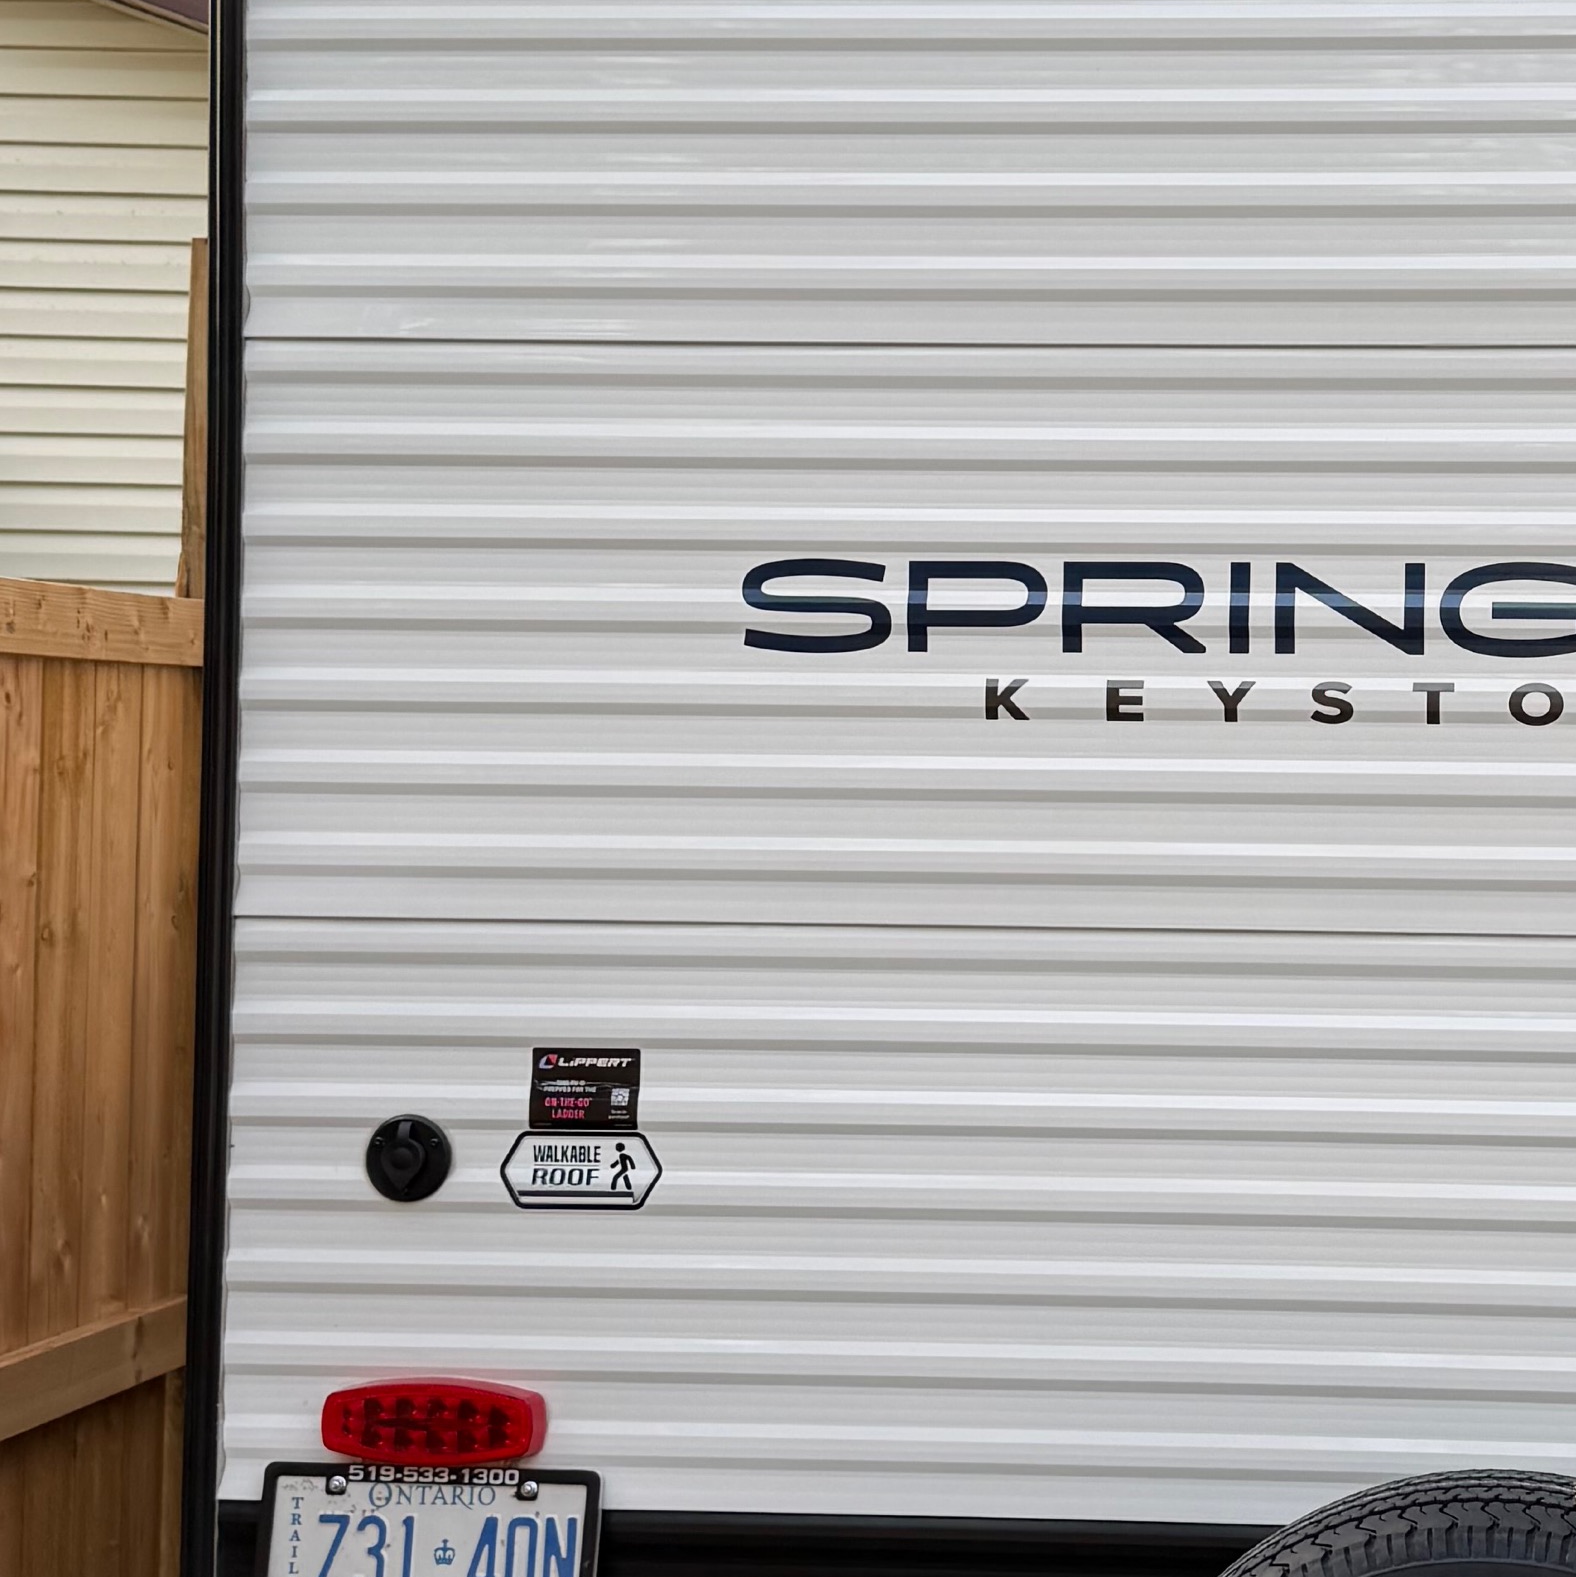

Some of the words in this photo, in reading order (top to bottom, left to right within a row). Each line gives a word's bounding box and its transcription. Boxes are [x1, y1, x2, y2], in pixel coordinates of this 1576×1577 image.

[533, 1144, 602, 1164] WALKABLE
[531, 1167, 600, 1186] ROOF
[348, 1465, 520, 1486] 519-533-1300
[368, 1482, 497, 1510] ONTARIO
